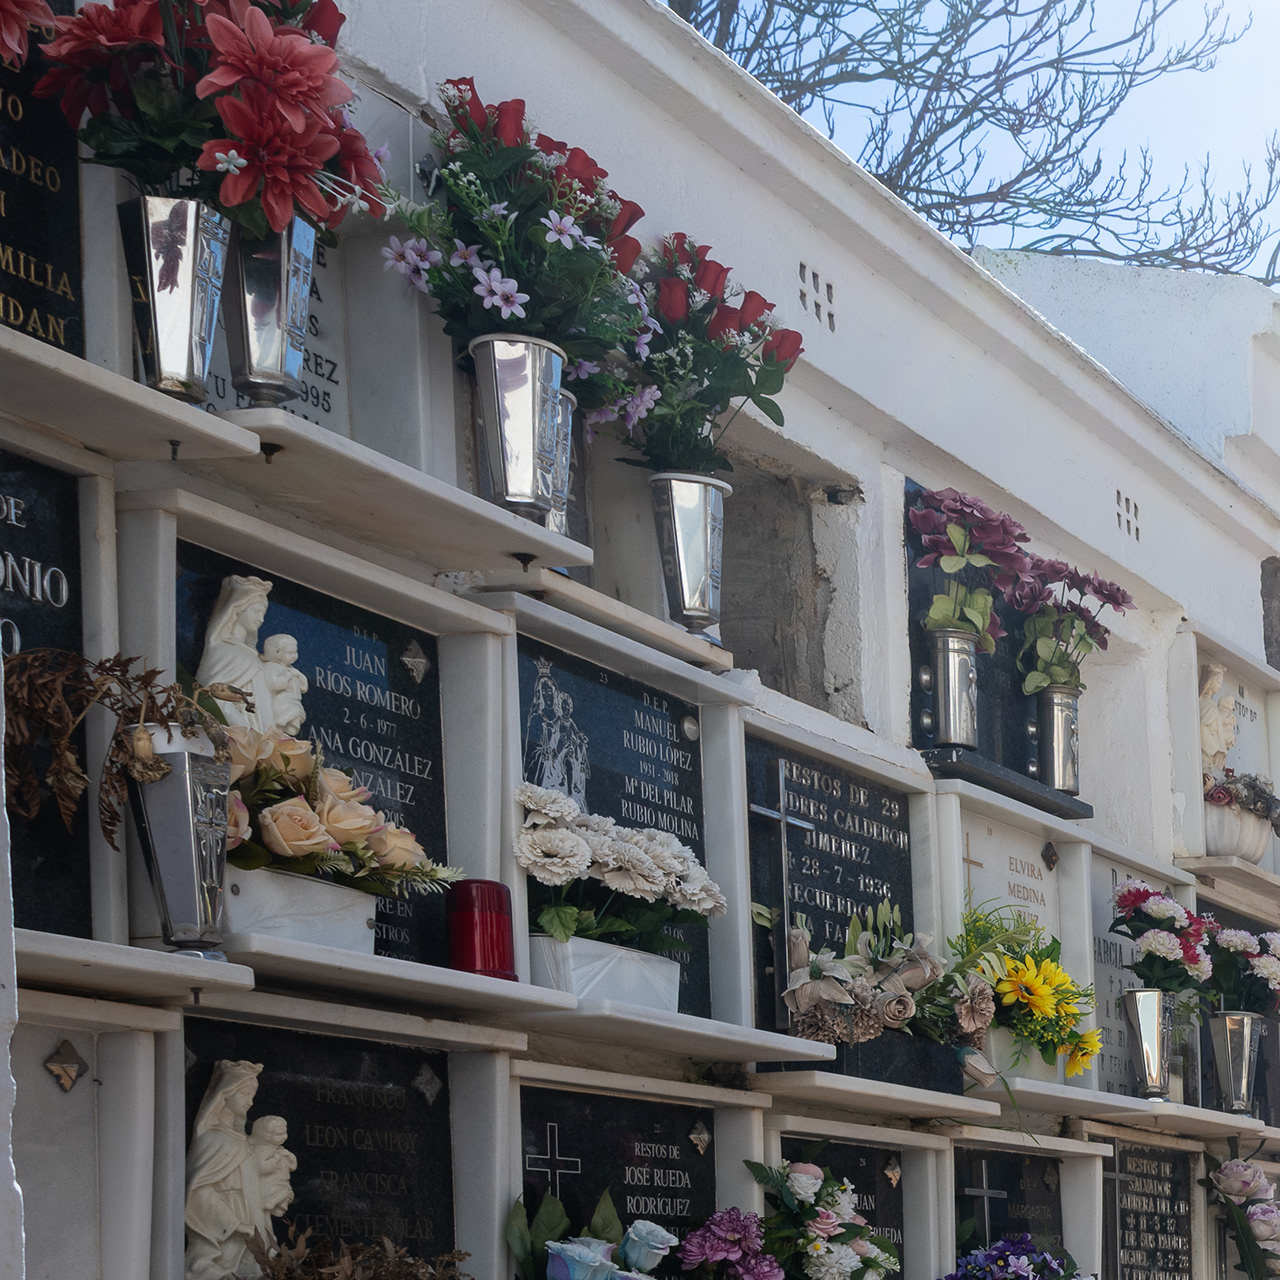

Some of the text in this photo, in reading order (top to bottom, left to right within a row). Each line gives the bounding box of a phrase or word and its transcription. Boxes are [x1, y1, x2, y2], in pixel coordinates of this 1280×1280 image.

[344, 645, 386, 677] JUAN
[315, 665, 421, 720] RÍOS ROMERO
[634, 709, 680, 743] MANUEL
[308, 725, 433, 780] ANA GONZÁLEZ
[623, 729, 693, 772] RUBIO LÓPEZ
[641, 780, 662, 805] DEL
[663, 788, 695, 816] PILAR
[784, 758, 899, 819] RESTOS DE 29
[621, 799, 699, 841] RUBIO MOLINA
[833, 808, 909, 850] CALDERON
[804, 830, 871, 866] JIMENEZ
[1008, 855, 1044, 881] ELVIRA
[1007, 880, 1047, 908] MEDINA
[634, 1142, 681, 1160] RESTOS DE
[624, 1164, 692, 1188] JOSÉ RUEDA
[626, 1192, 691, 1217] RODRÍGUEZ
[1007, 1202, 1053, 1220] MARGARITA
